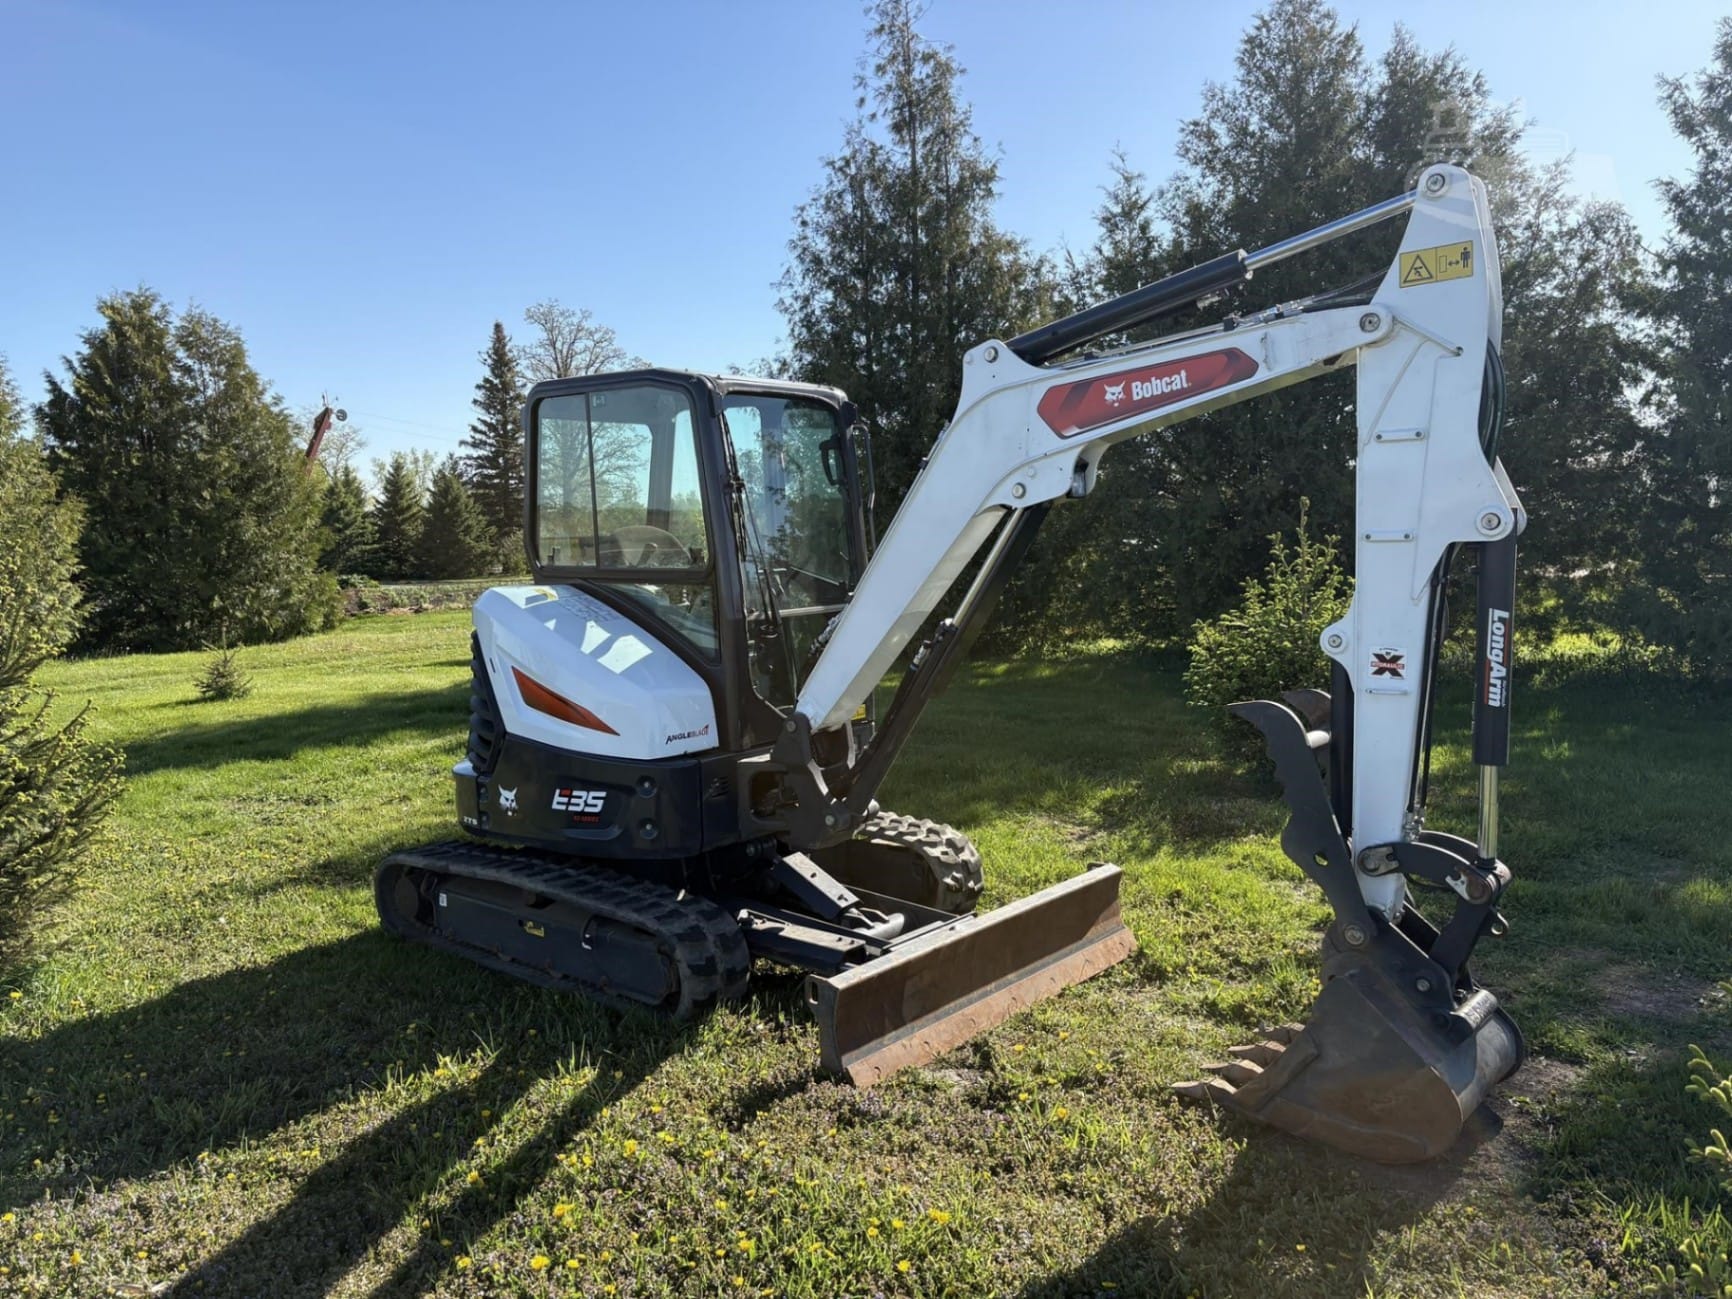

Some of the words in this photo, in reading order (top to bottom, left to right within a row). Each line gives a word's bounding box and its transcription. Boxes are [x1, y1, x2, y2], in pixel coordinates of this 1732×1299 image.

[1131, 369, 1188, 401] Bobcat
[1487, 608, 1509, 707] LongArm
[552, 789, 607, 812] E35
